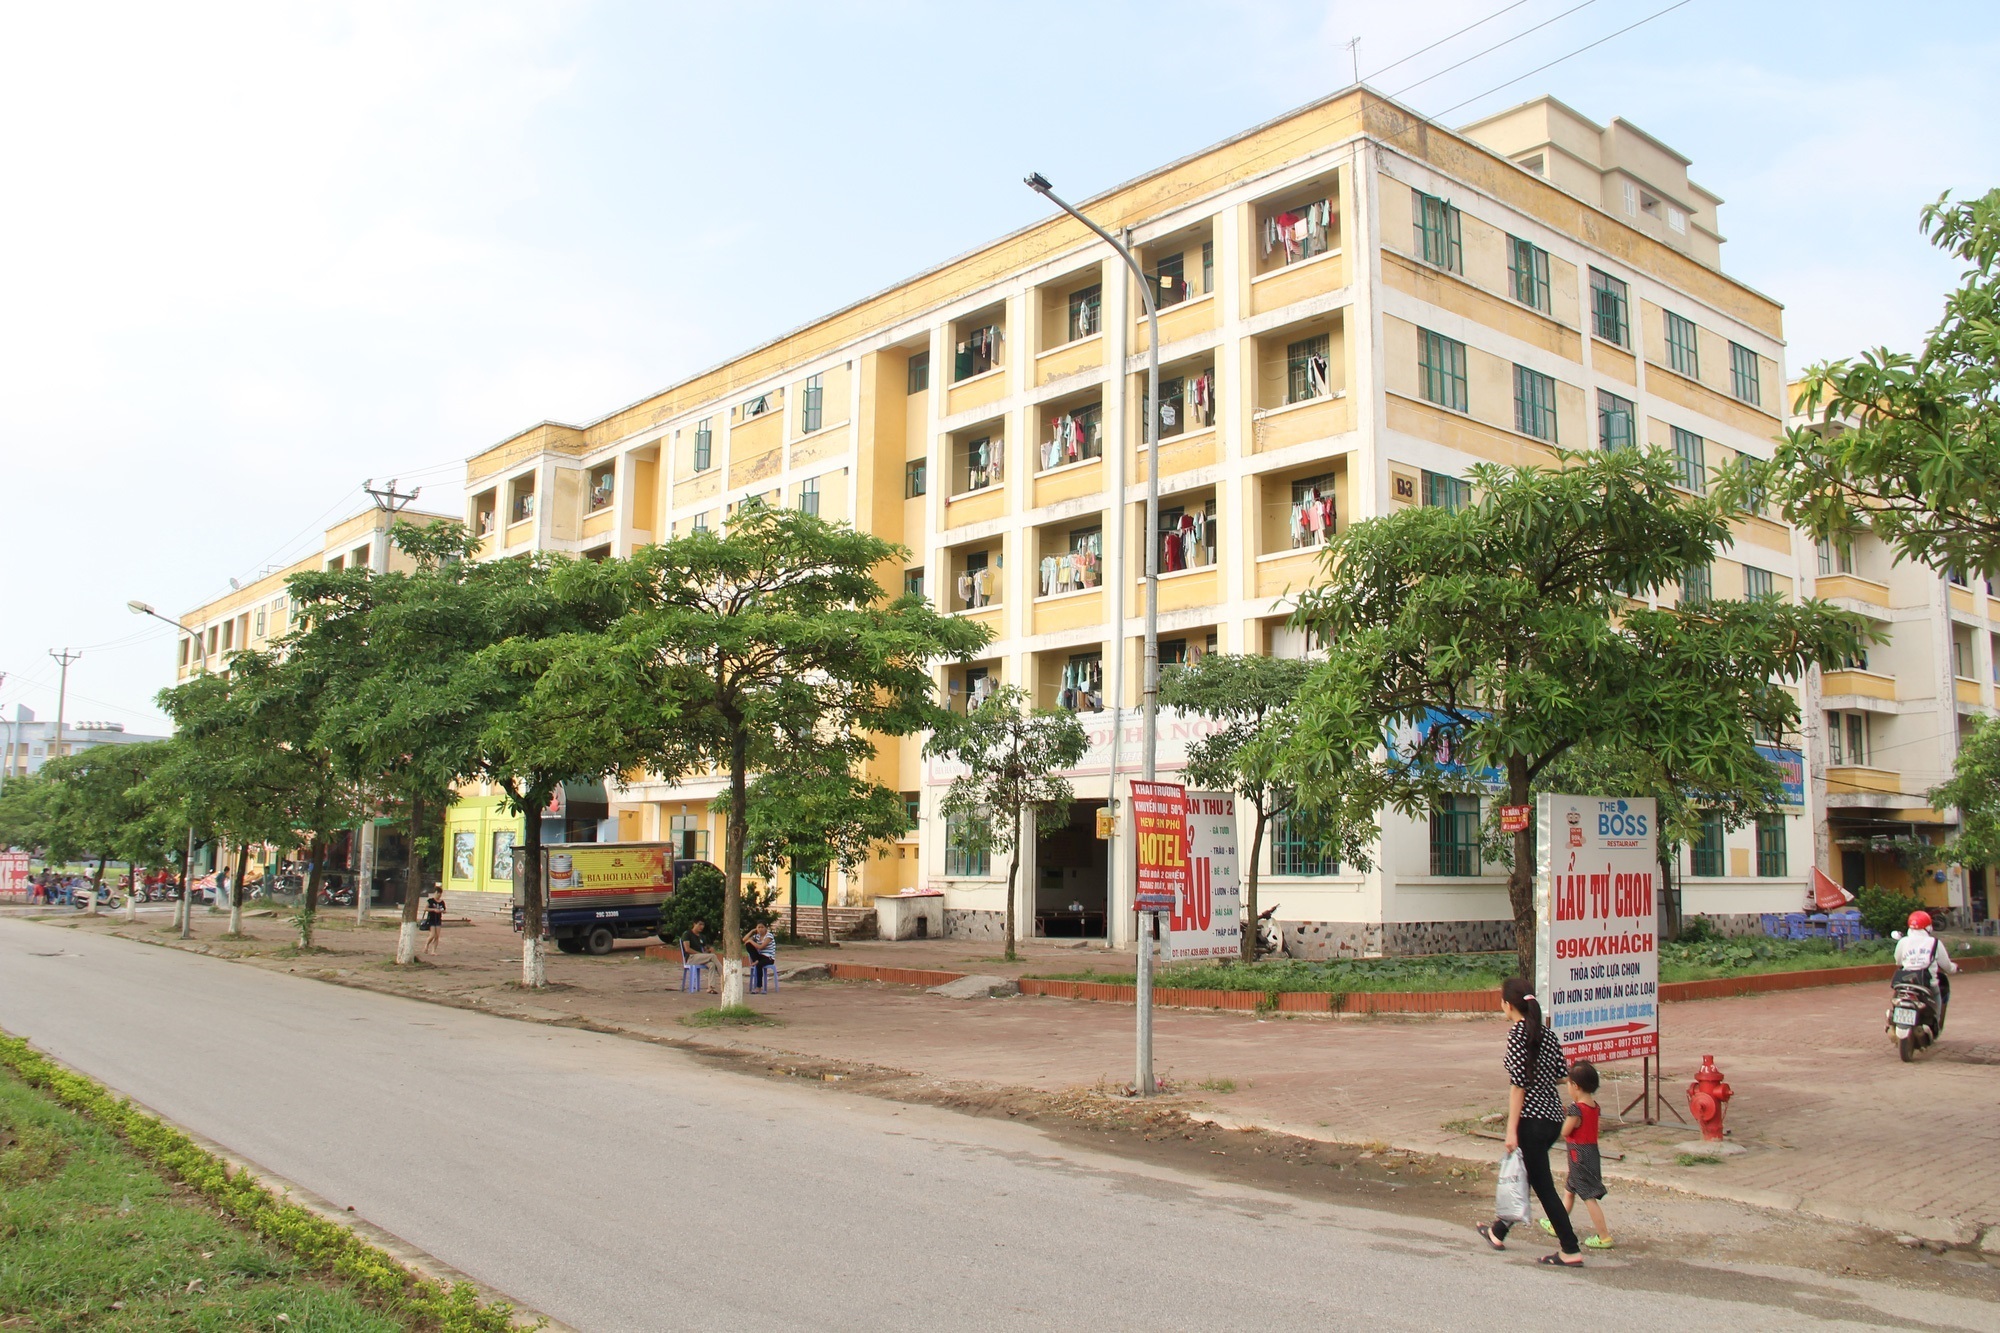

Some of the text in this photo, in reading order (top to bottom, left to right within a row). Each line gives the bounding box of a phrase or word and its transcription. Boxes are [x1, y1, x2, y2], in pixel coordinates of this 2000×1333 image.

[1397, 478, 1413, 497] B3
[1135, 784, 1152, 795] KHAI
[1171, 804, 1183, 815] 50%
[1226, 800, 1233, 815] 2
[1599, 802, 1615, 812] THE
[1140, 817, 1154, 827] NEW
[1598, 814, 1647, 836] BOSS
[1139, 832, 1185, 866] HOTEL
[588, 874, 601, 882] BIA
[621, 871, 632, 880] HÀ
[635, 870, 649, 880] NỘI
[1556, 852, 1651, 930] LẨU TỰ CHỌN
[1556, 931, 1652, 959] 99K/KHÁCH
[1570, 962, 1640, 981] THỎA SỨC LỰA CHỌN
[1553, 981, 1655, 1005] VỚI HƠN 50 MÓN ĂN CÁC LOẠI
[1564, 1030, 1583, 1041] 50M
[1578, 1044, 1591, 1053] 0947
[1593, 1042, 1602, 1051] 903
[1618, 1038, 1631, 1047] 0917
[1632, 1036, 1641, 1045] 531
[1642, 1035, 1652, 1044] 922
